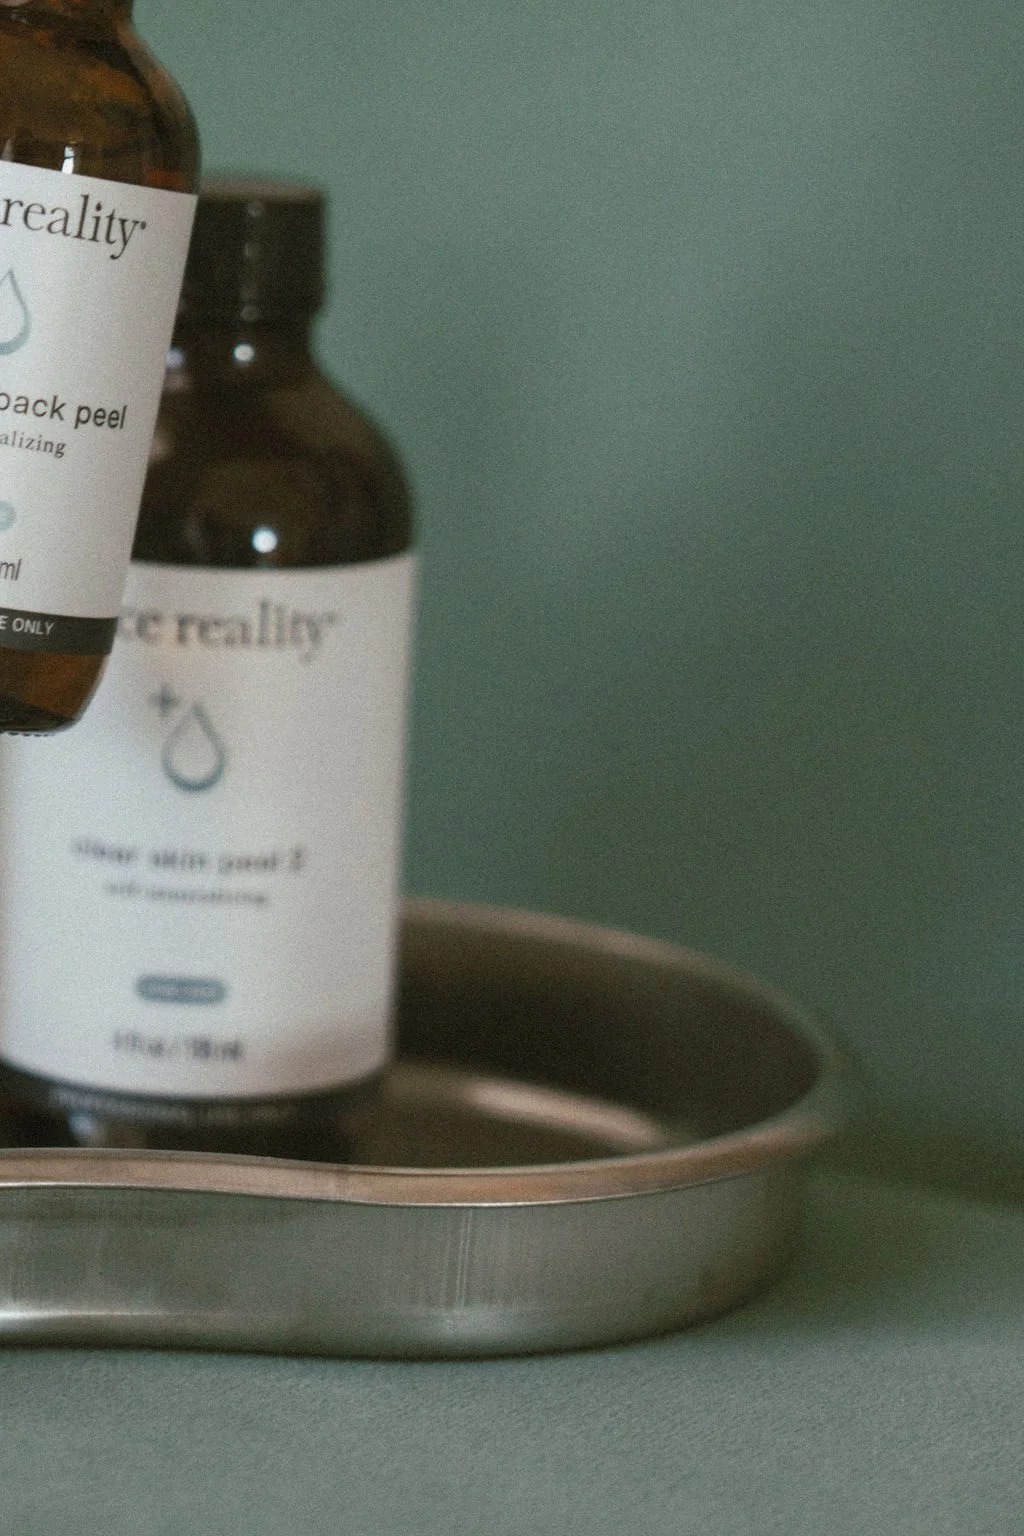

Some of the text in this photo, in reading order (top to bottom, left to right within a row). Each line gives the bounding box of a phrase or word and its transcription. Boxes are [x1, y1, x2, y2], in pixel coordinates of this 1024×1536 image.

[73, 404, 129, 430] peel
[12, 617, 55, 636] ONLY
[115, 595, 328, 666] ce reality
